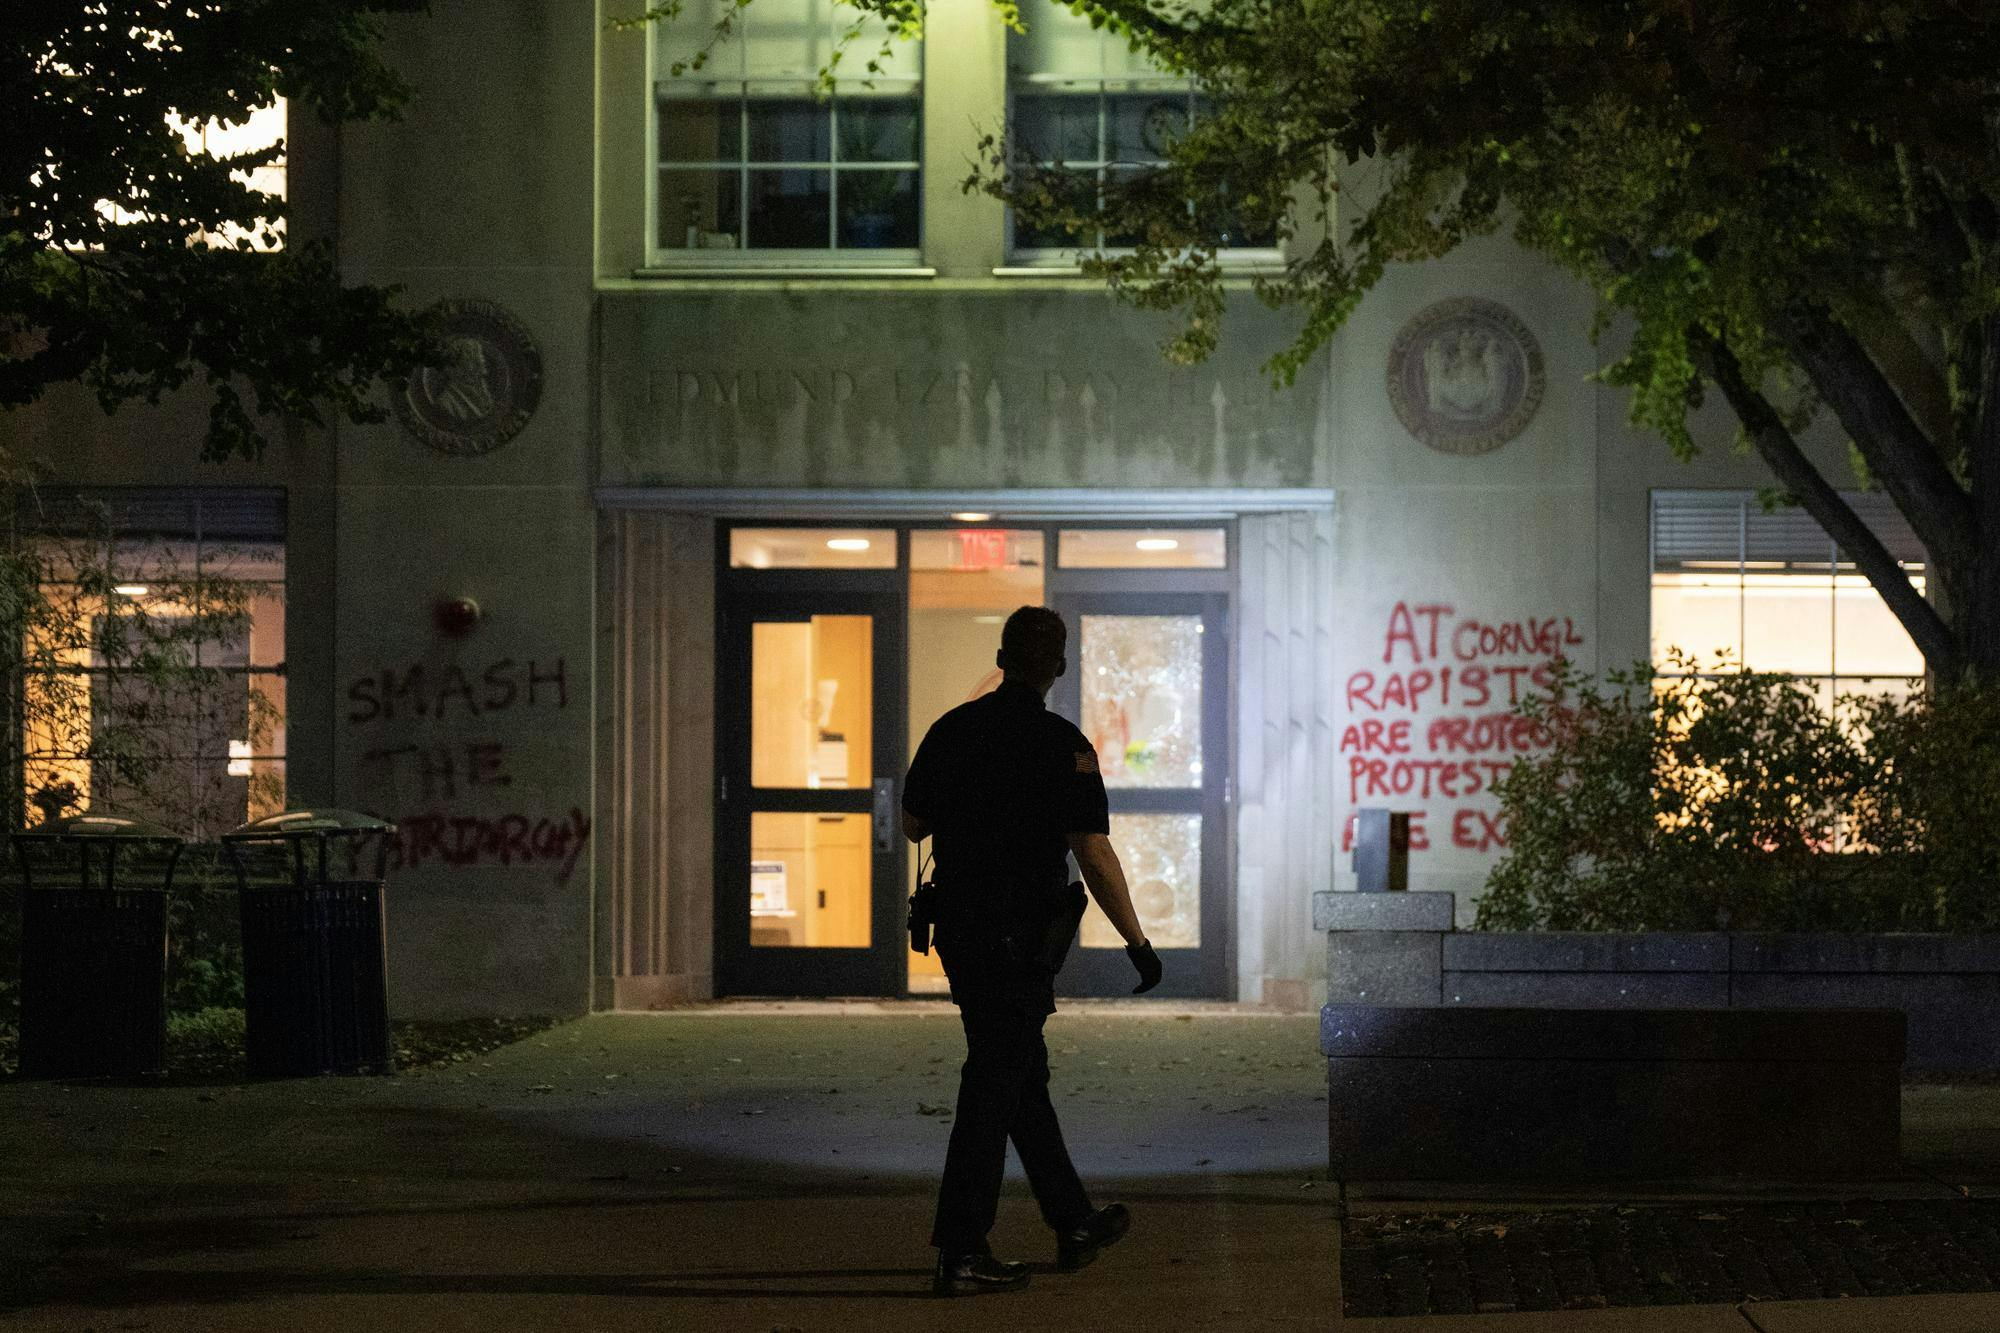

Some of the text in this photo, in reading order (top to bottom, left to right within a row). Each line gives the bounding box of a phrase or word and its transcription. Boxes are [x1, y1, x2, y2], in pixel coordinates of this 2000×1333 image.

[647, 368, 858, 405] EDMUND
[1383, 600, 1455, 664] AT
[348, 656, 568, 724] SMASH
[1346, 663, 1560, 712] RAPISTS
[1341, 718, 1412, 754] ARE
[363, 742, 512, 800] THE
